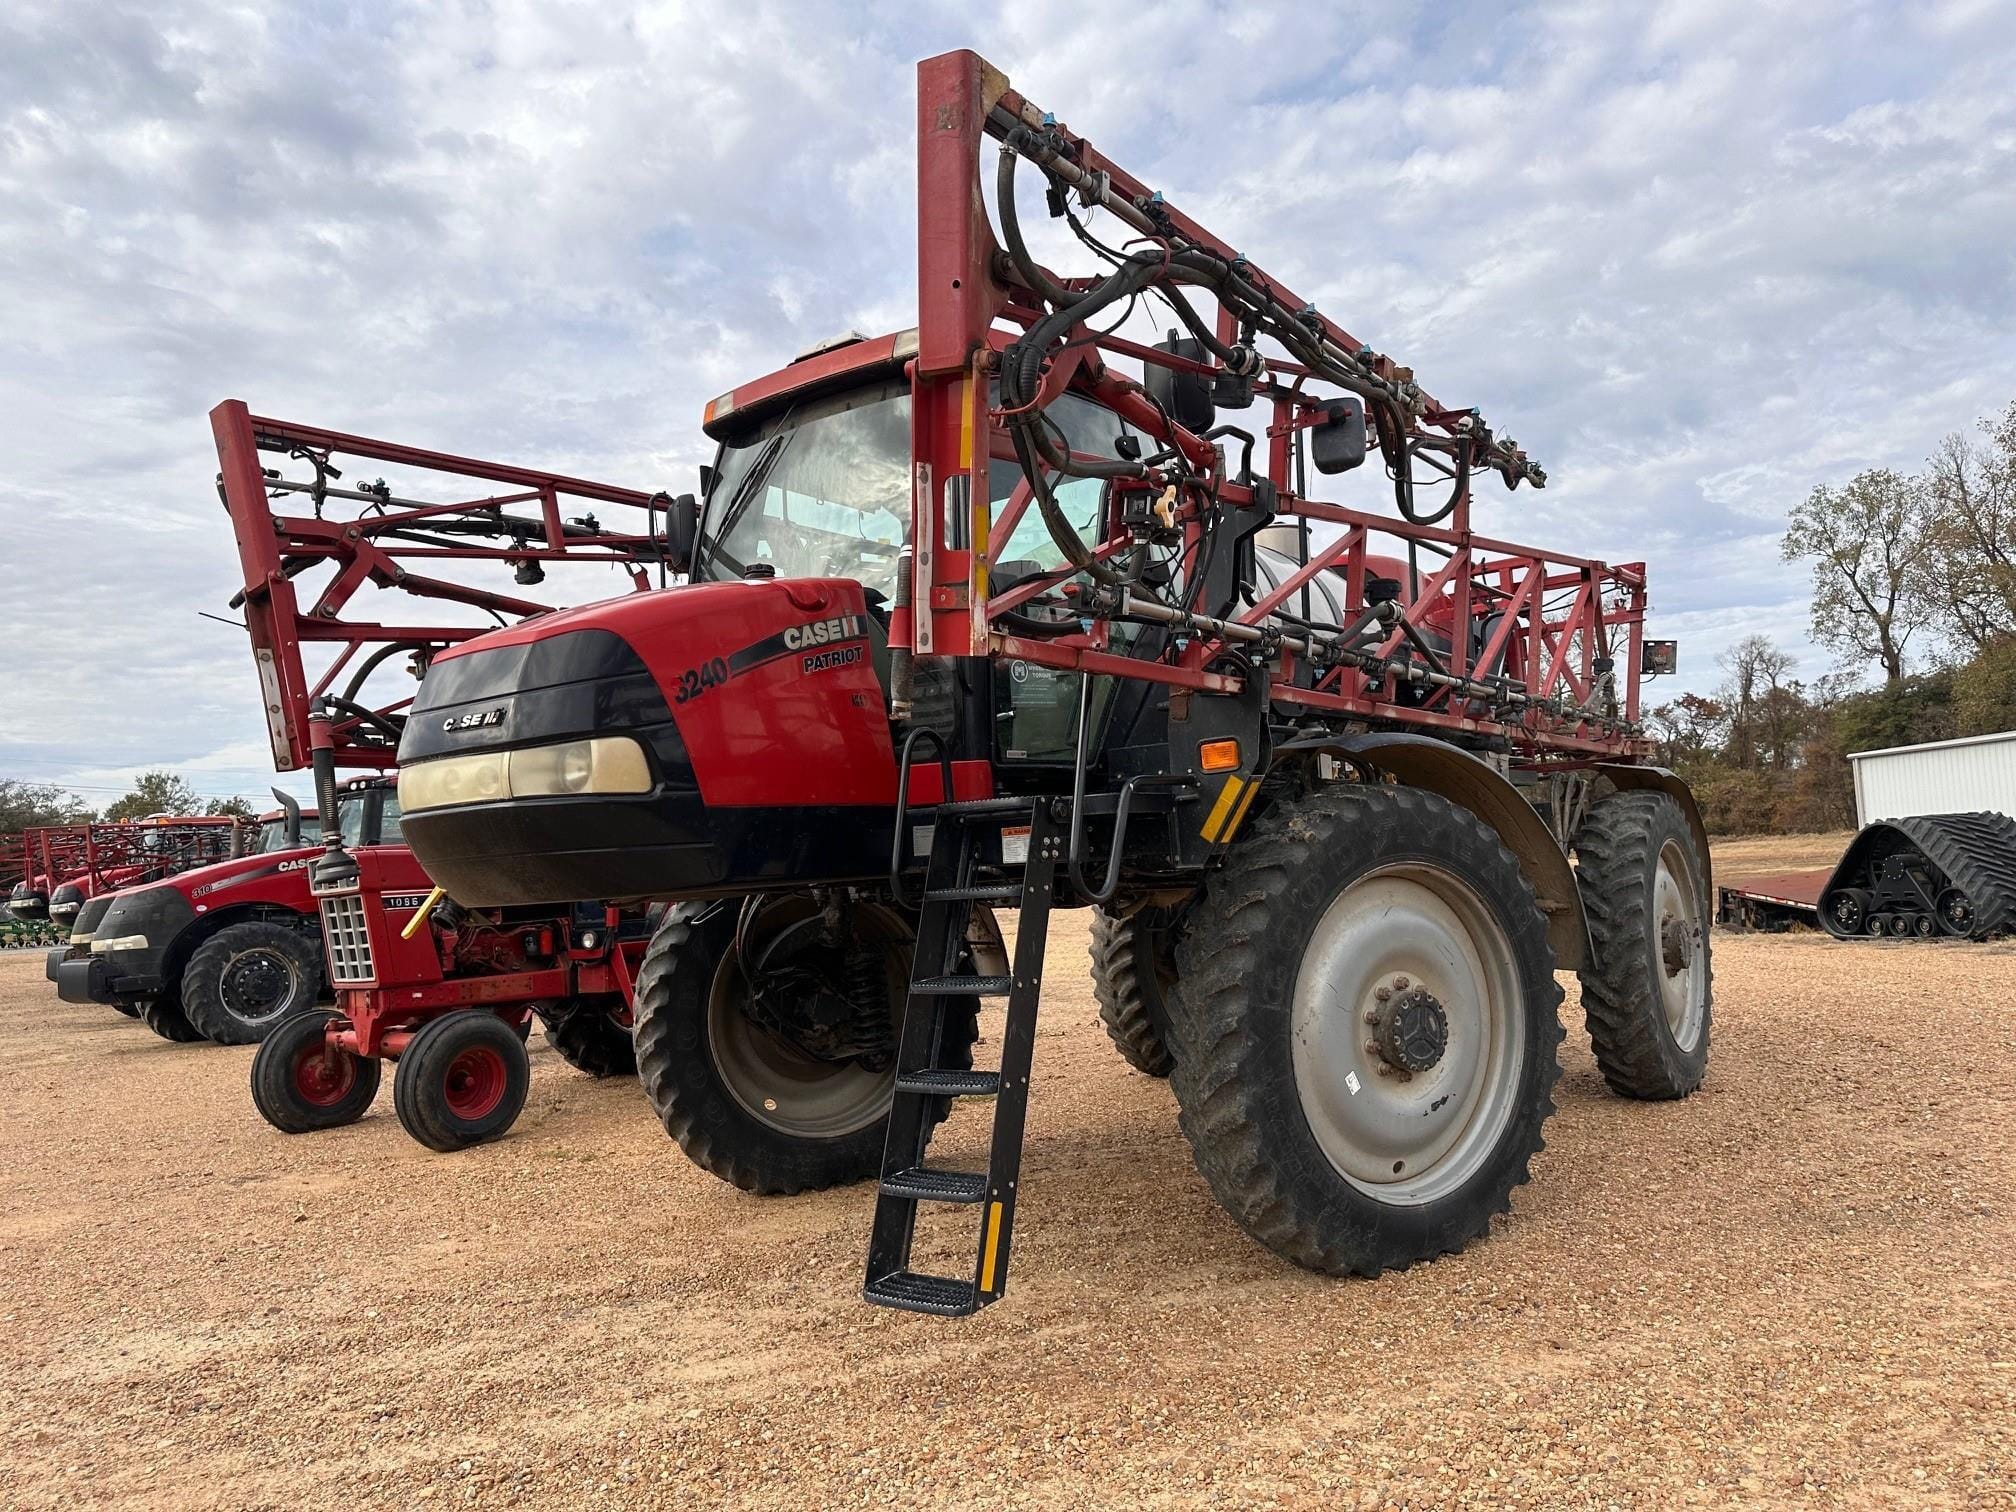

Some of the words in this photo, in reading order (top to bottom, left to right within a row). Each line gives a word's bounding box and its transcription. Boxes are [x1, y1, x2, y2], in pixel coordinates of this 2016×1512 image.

[784, 618, 842, 650] CASE
[803, 646, 863, 673] PATRIOT
[673, 656, 728, 704] 3240
[443, 713, 483, 731] CSE
[278, 859, 307, 872] CAS
[192, 883, 213, 899] 310
